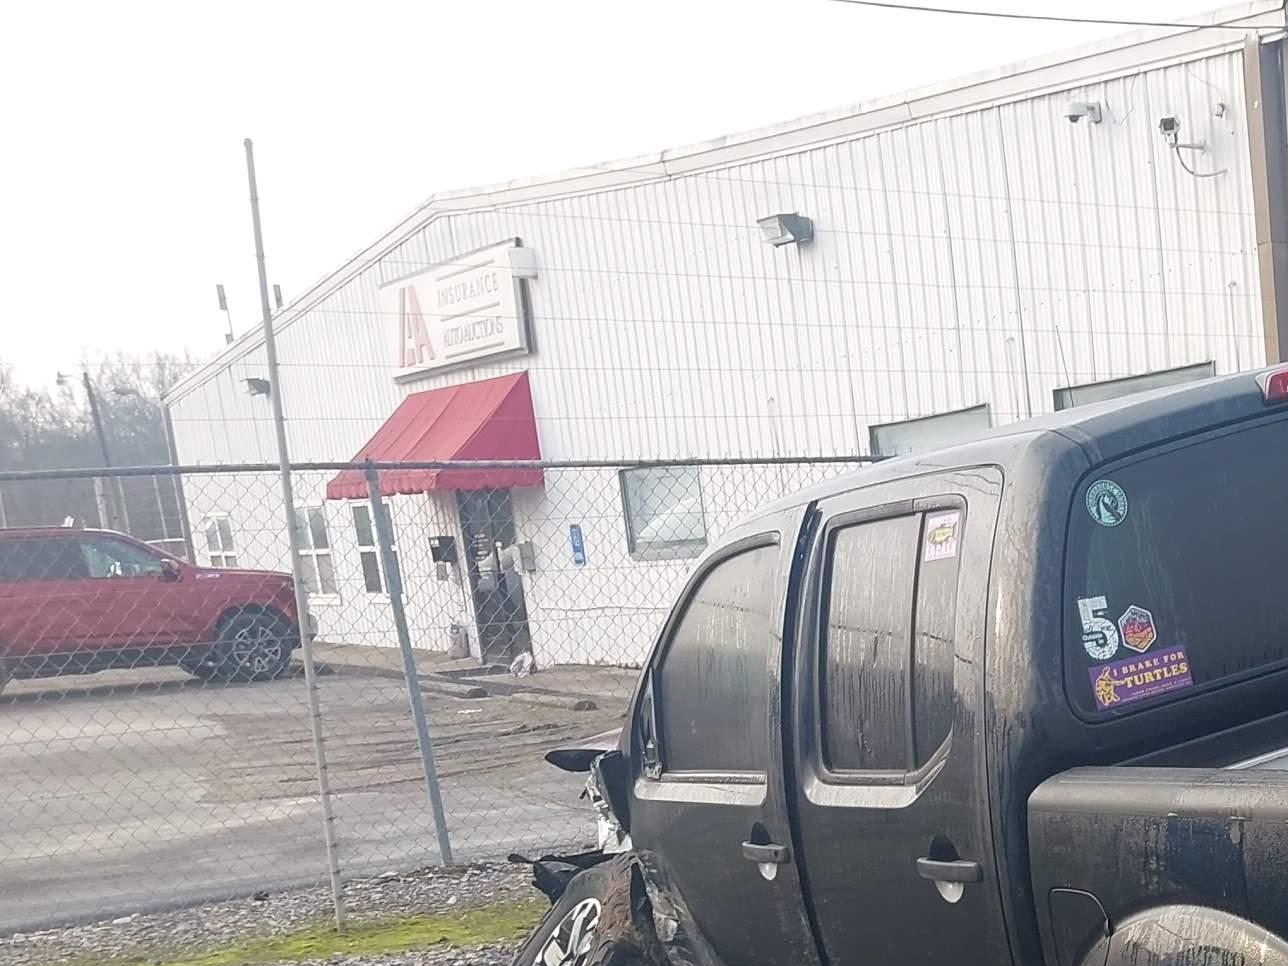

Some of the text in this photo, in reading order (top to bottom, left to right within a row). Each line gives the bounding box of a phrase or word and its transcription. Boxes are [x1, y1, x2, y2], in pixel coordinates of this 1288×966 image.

[437, 272, 500, 307] INSURANCE
[1077, 595, 1119, 661] 5
[1112, 651, 1185, 678] I BRAKE FOR
[1123, 662, 1189, 689] TURTLES
